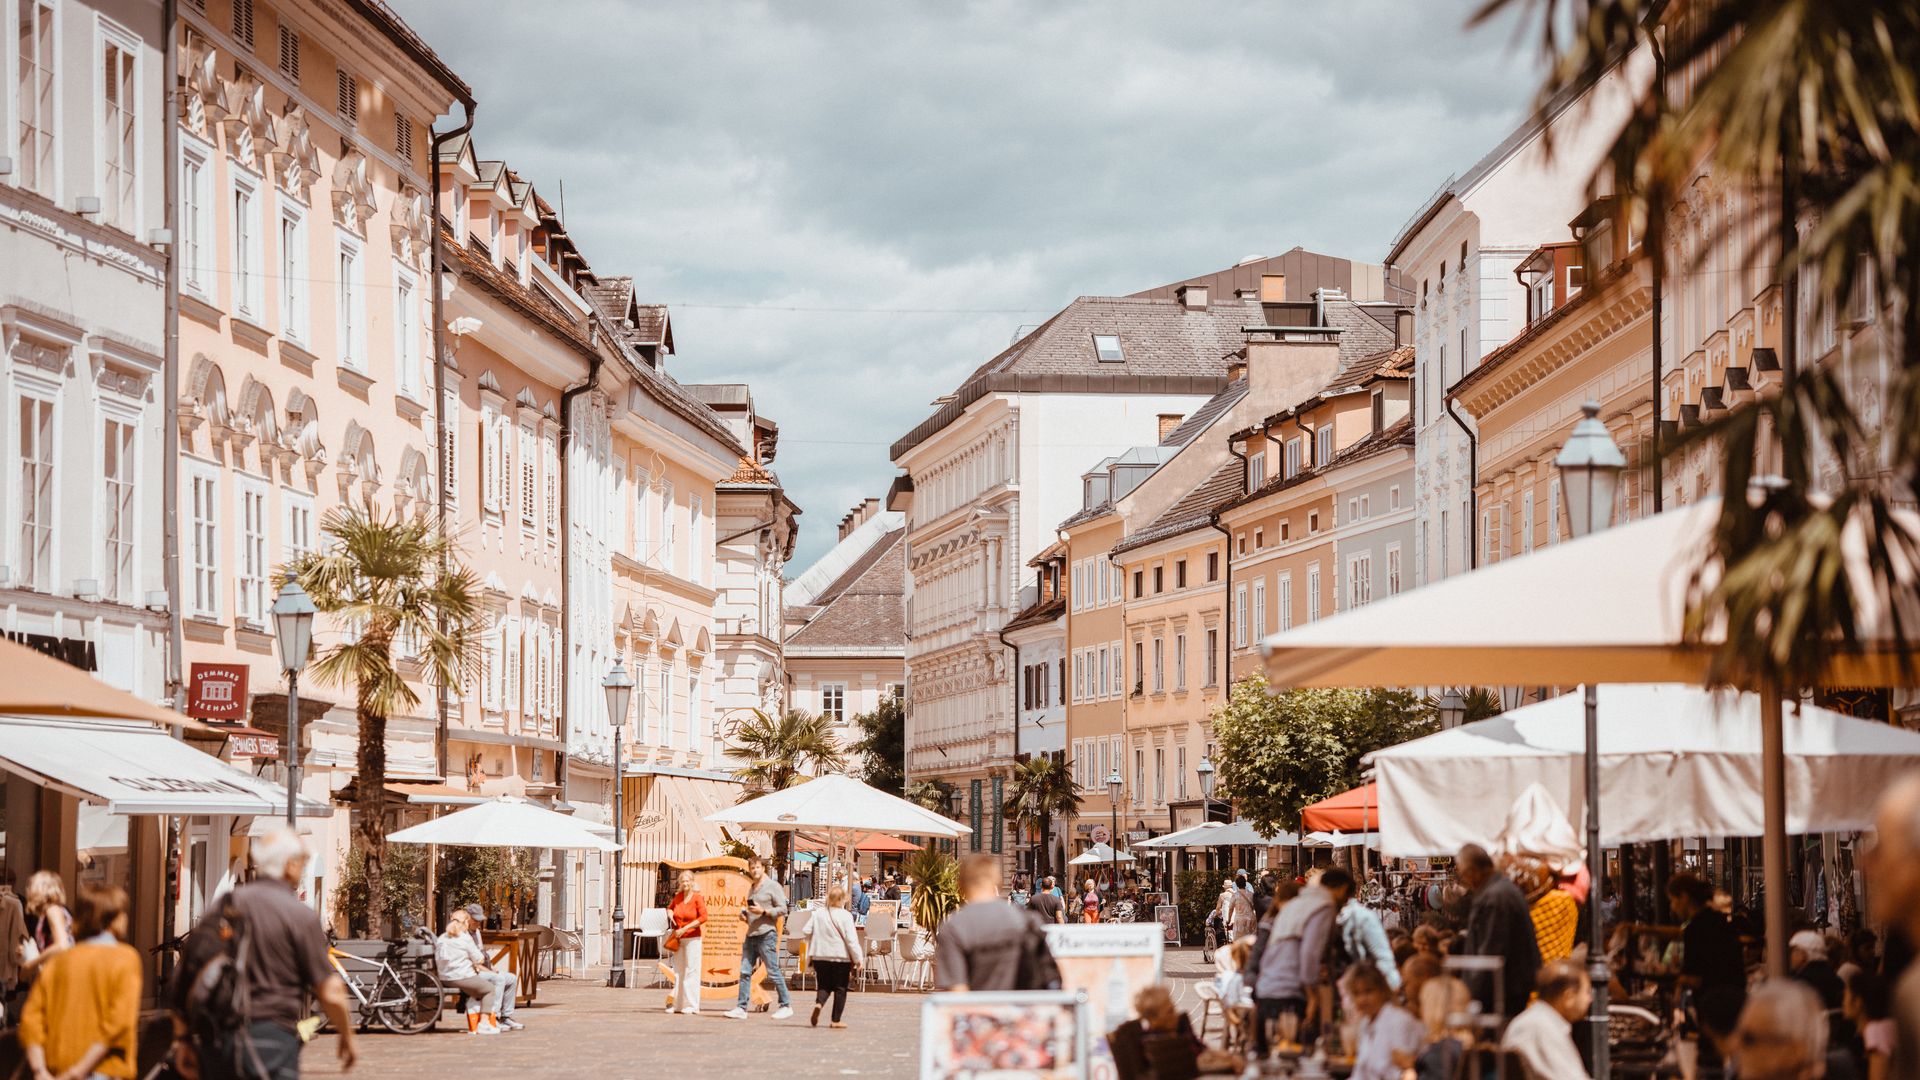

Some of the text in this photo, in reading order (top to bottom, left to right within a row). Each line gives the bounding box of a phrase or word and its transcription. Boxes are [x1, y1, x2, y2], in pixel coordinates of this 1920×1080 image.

[196, 669, 240, 682] DEMMERS
[194, 700, 239, 711] TEEHAUS
[231, 735, 279, 755] DEMMERS TEEHAUS
[703, 894, 748, 910] ANDALA
